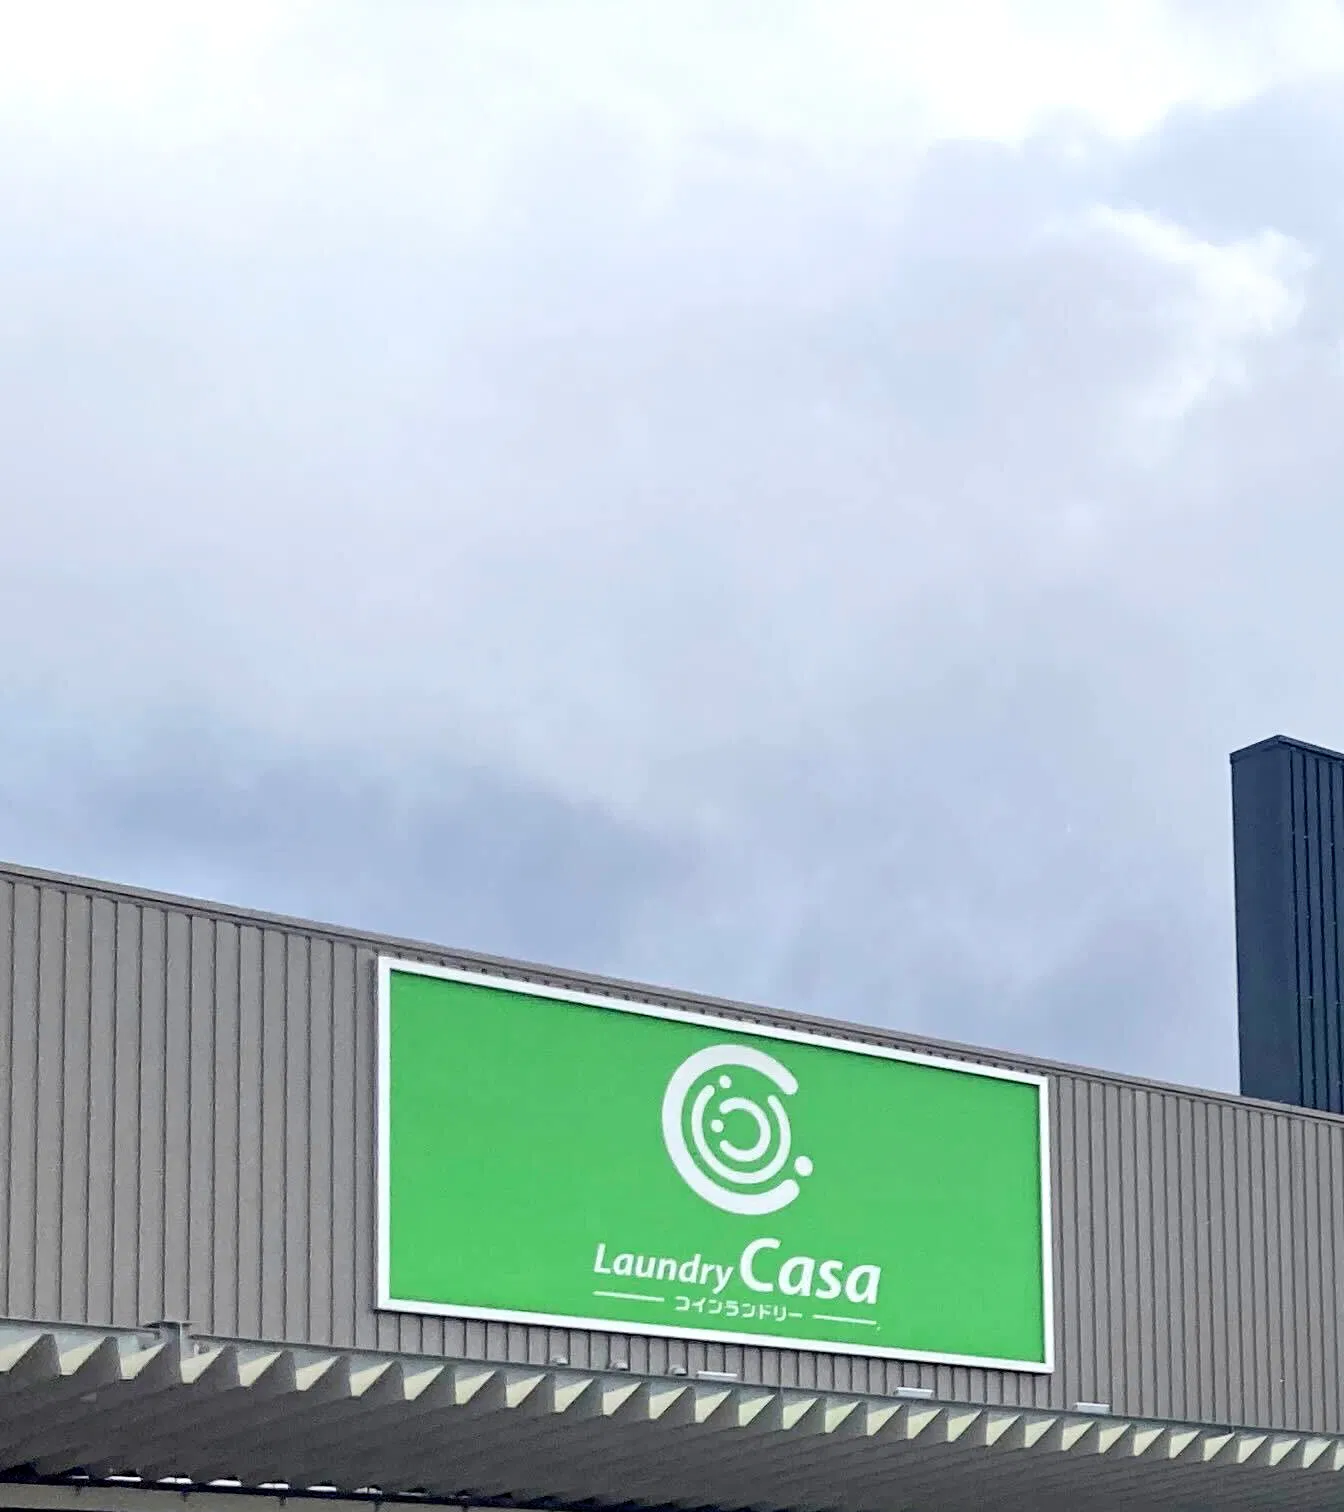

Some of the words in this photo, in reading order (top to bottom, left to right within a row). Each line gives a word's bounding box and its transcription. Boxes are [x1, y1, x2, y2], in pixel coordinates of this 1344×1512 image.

[593, 1243, 735, 1295] Laundry
[739, 1238, 883, 1305] Casa
[674, 1296, 803, 1322] コインランドリー
